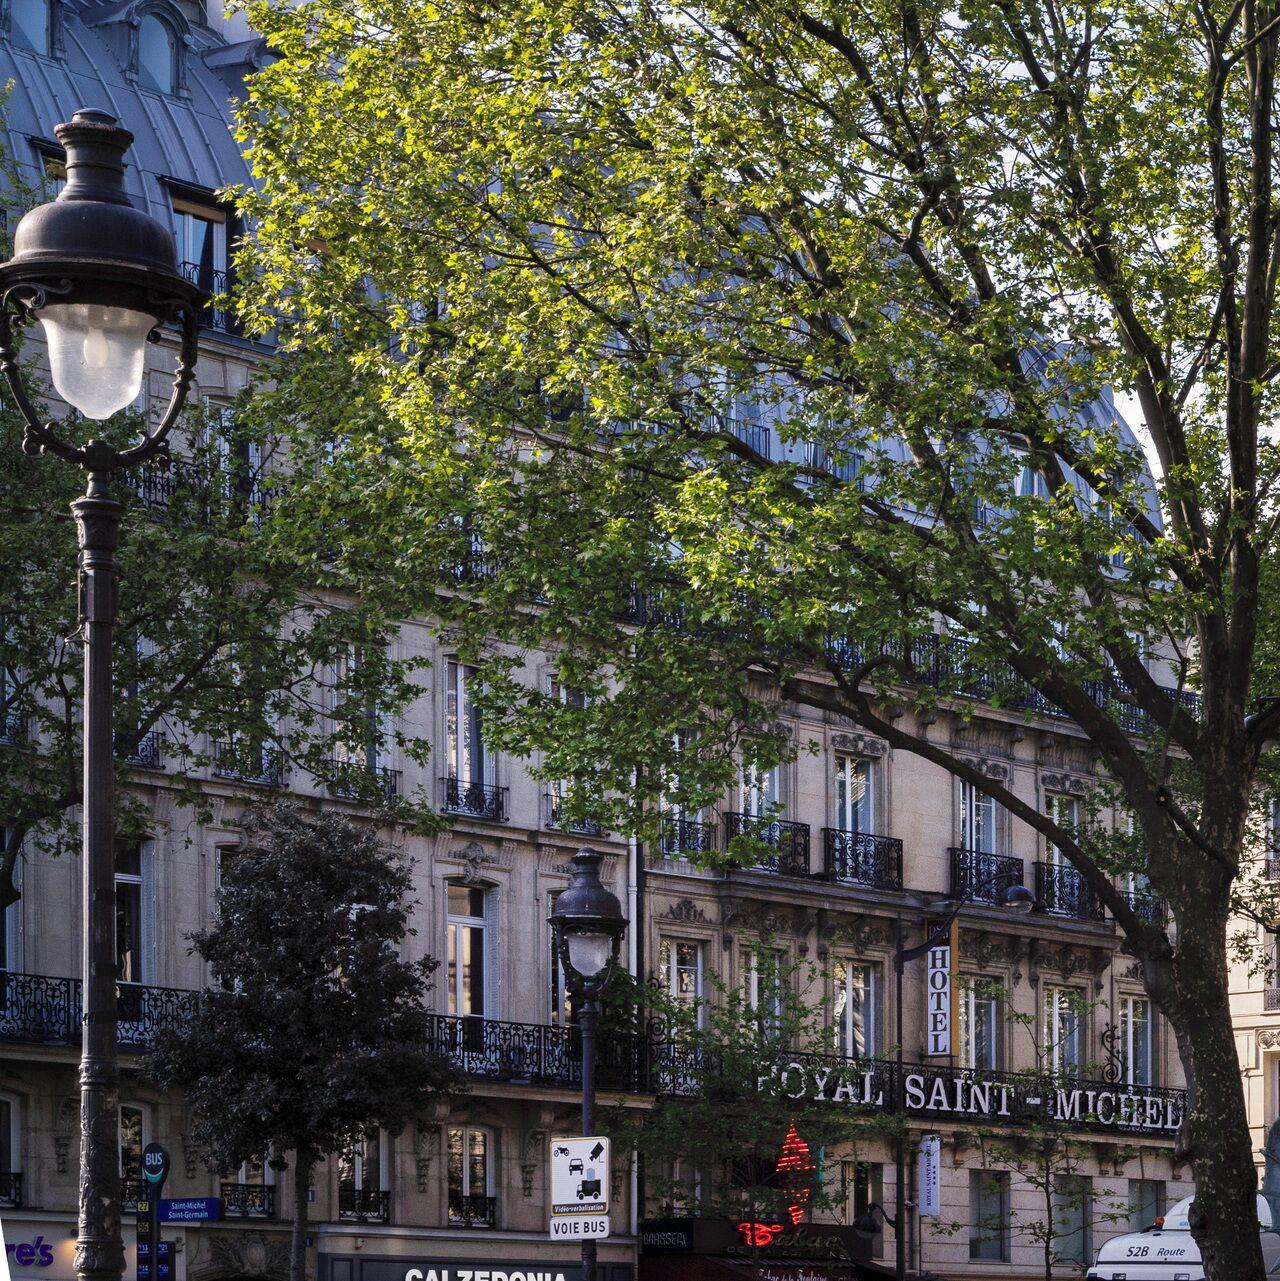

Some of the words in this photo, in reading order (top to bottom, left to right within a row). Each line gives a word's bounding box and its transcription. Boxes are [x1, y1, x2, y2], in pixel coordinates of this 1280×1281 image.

[930, 949, 948, 1054] HOTEL
[905, 1074, 1015, 1116] SAINT
[1054, 1088, 1183, 1130] MICHEL
[146, 1152, 163, 1166] BUS
[140, 1201, 148, 1211] 27
[171, 1201, 206, 1210] Saint-Michel
[555, 1204, 604, 1213] Vidéo-verbalisation
[168, 1210, 209, 1219] Saint-Germain
[553, 1222, 580, 1235] VOIE
[584, 1221, 606, 1233] BUS
[1126, 1246, 1149, 1257] S2B
[1156, 1247, 1186, 1257] Route
